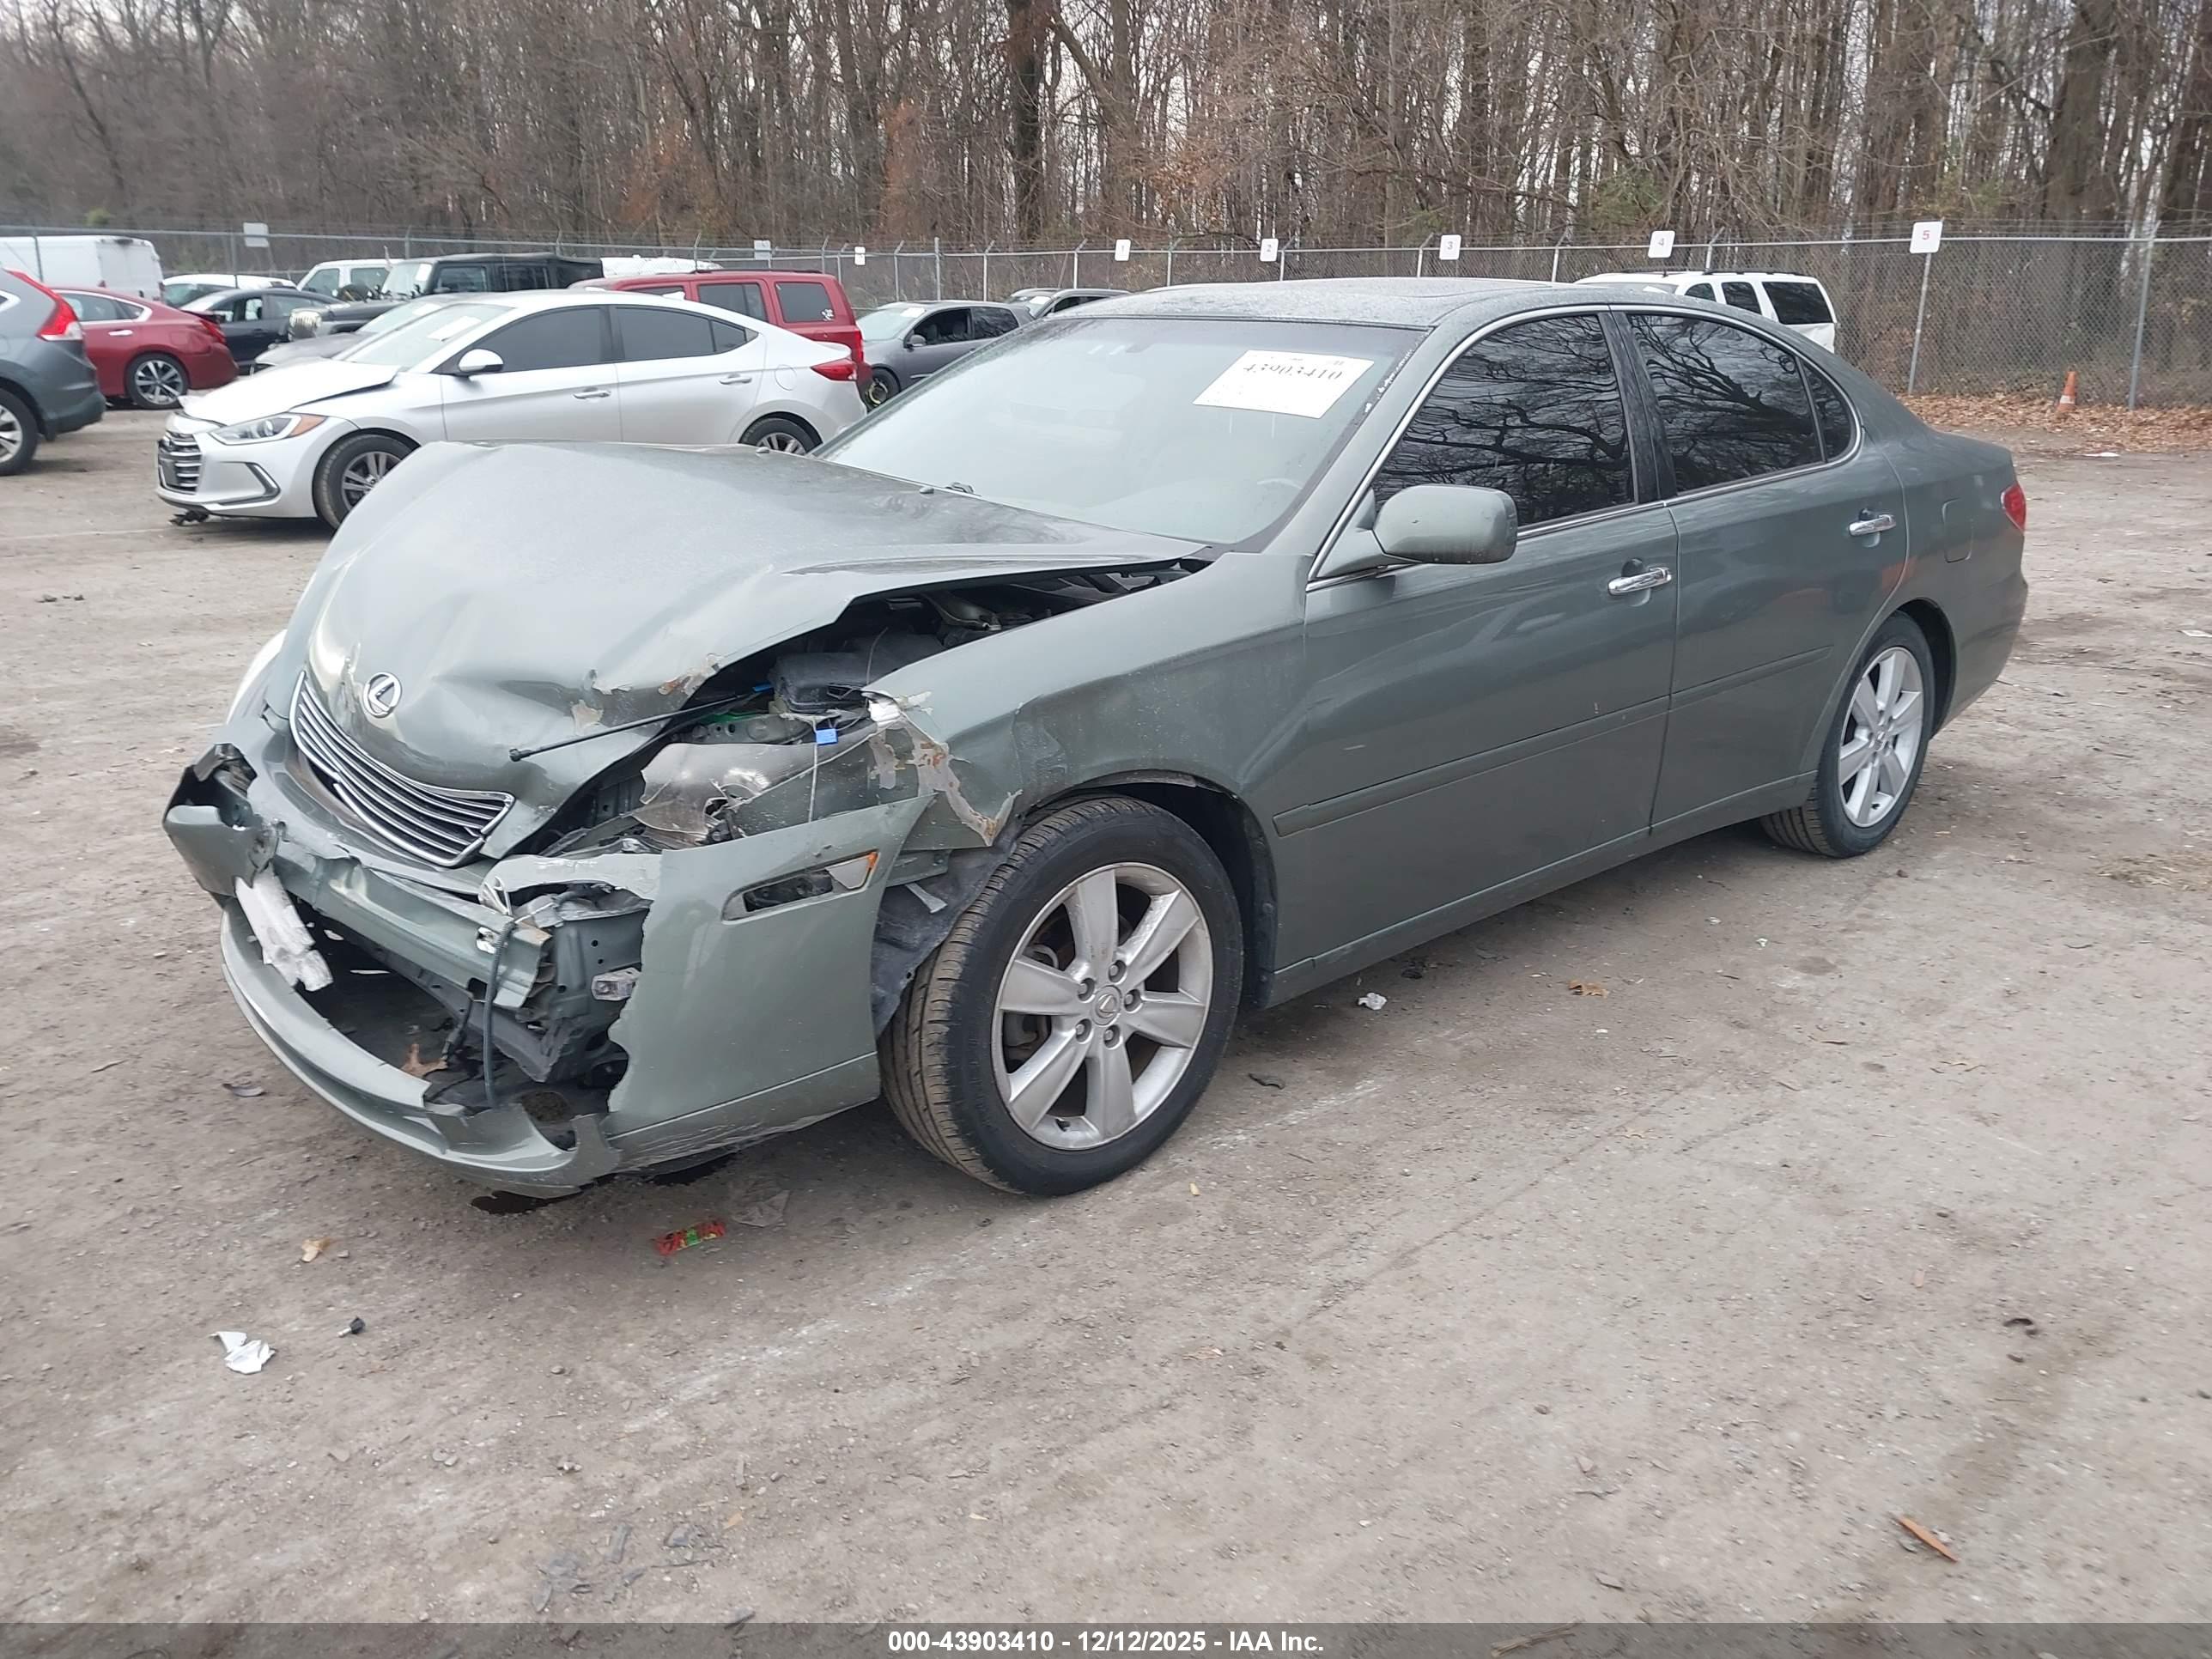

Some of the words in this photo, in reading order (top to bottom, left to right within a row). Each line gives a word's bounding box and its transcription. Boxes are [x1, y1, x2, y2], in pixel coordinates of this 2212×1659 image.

[1922, 229, 1930, 240] 5
[1447, 240, 1453, 250] 3
[1657, 237, 1665, 246] 4
